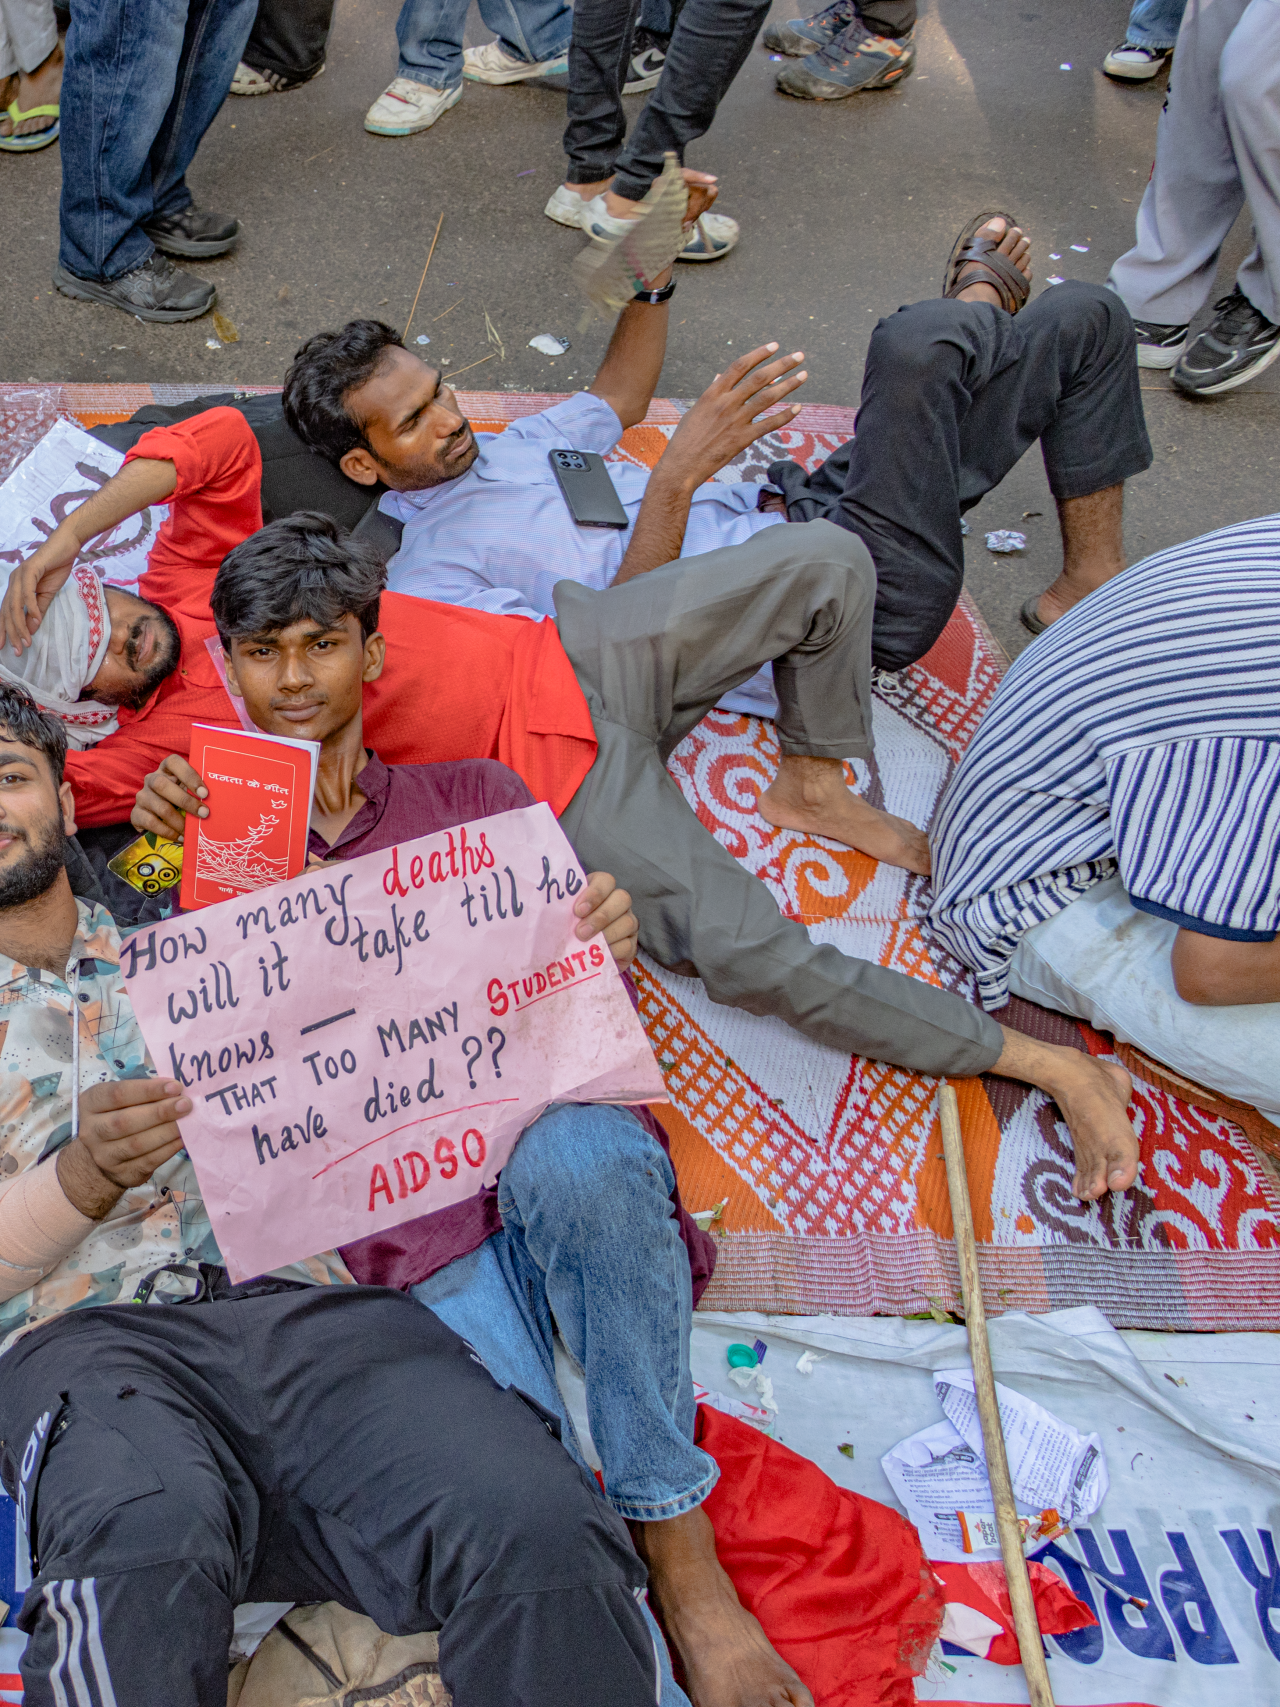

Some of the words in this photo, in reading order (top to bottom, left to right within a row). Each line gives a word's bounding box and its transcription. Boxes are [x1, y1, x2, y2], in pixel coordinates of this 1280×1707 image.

[207, 771, 243, 785] जनता
[246, 778, 260, 788] के
[263, 782, 290, 795] गीत
[120, 926, 207, 979] How
[236, 874, 353, 946] many
[382, 827, 496, 898] deaths
[167, 960, 240, 1025] will
[259, 941, 291, 997] it
[350, 903, 430, 976] take
[461, 868, 524, 927] till
[536, 856, 583, 904] he
[168, 1030, 276, 1088] knows
[205, 1076, 278, 1116] THAT
[377, 1002, 459, 1058] MANY
[486, 944, 606, 1017] STUDENTS
[251, 1105, 328, 1165] have
[364, 1058, 444, 1123] died
[368, 1128, 487, 1212] AIDSO
